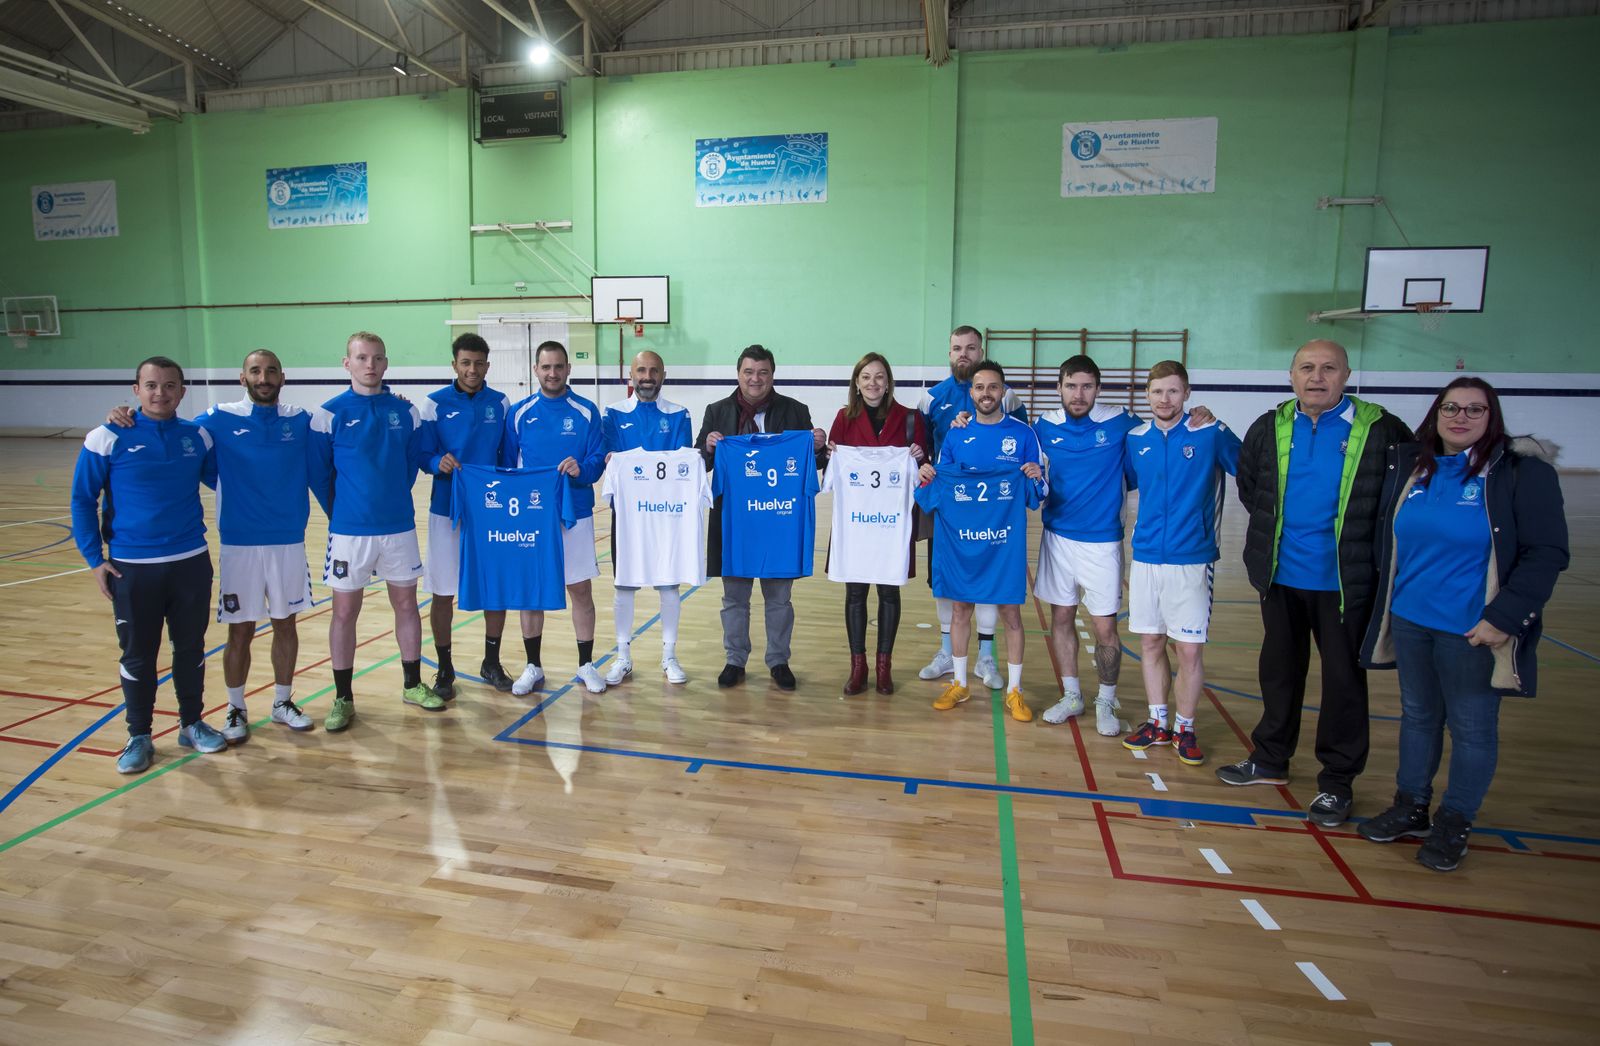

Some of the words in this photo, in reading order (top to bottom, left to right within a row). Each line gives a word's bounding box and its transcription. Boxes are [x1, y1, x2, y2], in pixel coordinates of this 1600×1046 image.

[484, 115, 505, 123] LOCAL
[524, 110, 558, 120] VISITANTE
[1102, 132, 1160, 140] Ayuntamiento
[726, 153, 776, 162] Ayuntamiento
[656, 462, 666, 480] 8
[768, 468, 778, 487] 9
[870, 470, 880, 488] 3
[977, 482, 988, 502] 2
[508, 498, 520, 516] 8
[638, 501, 683, 512] Huelva
[748, 498, 792, 511] Huelva
[852, 512, 896, 524] Huelva
[488, 530, 536, 542] Huelva
[959, 528, 1008, 540] Huelva
